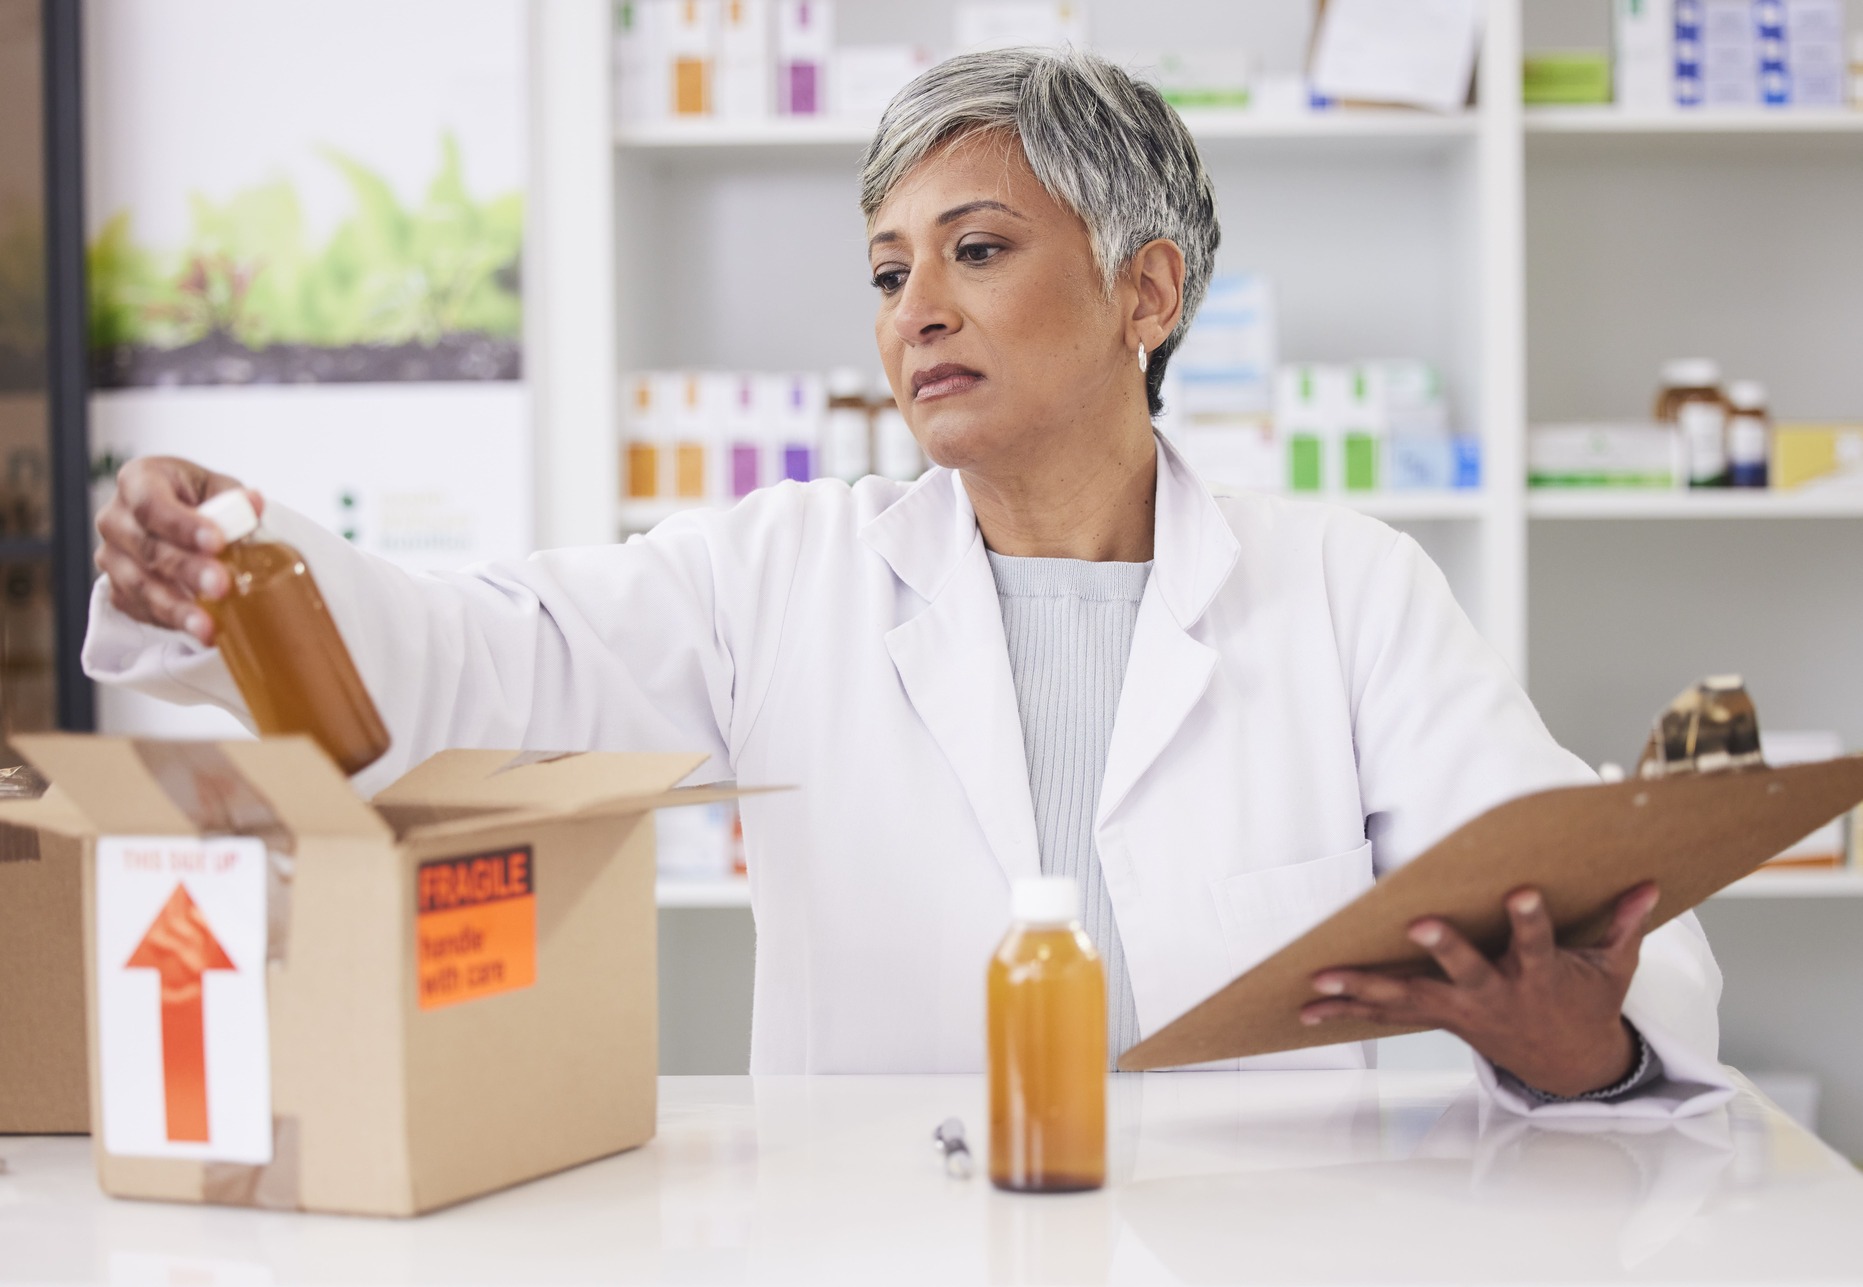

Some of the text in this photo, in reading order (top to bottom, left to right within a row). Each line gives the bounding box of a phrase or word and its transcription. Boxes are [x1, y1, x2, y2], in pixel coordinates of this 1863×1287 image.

[419, 852, 528, 908] FRAGILE
[421, 926, 484, 960] handle
[421, 966, 458, 996] with
